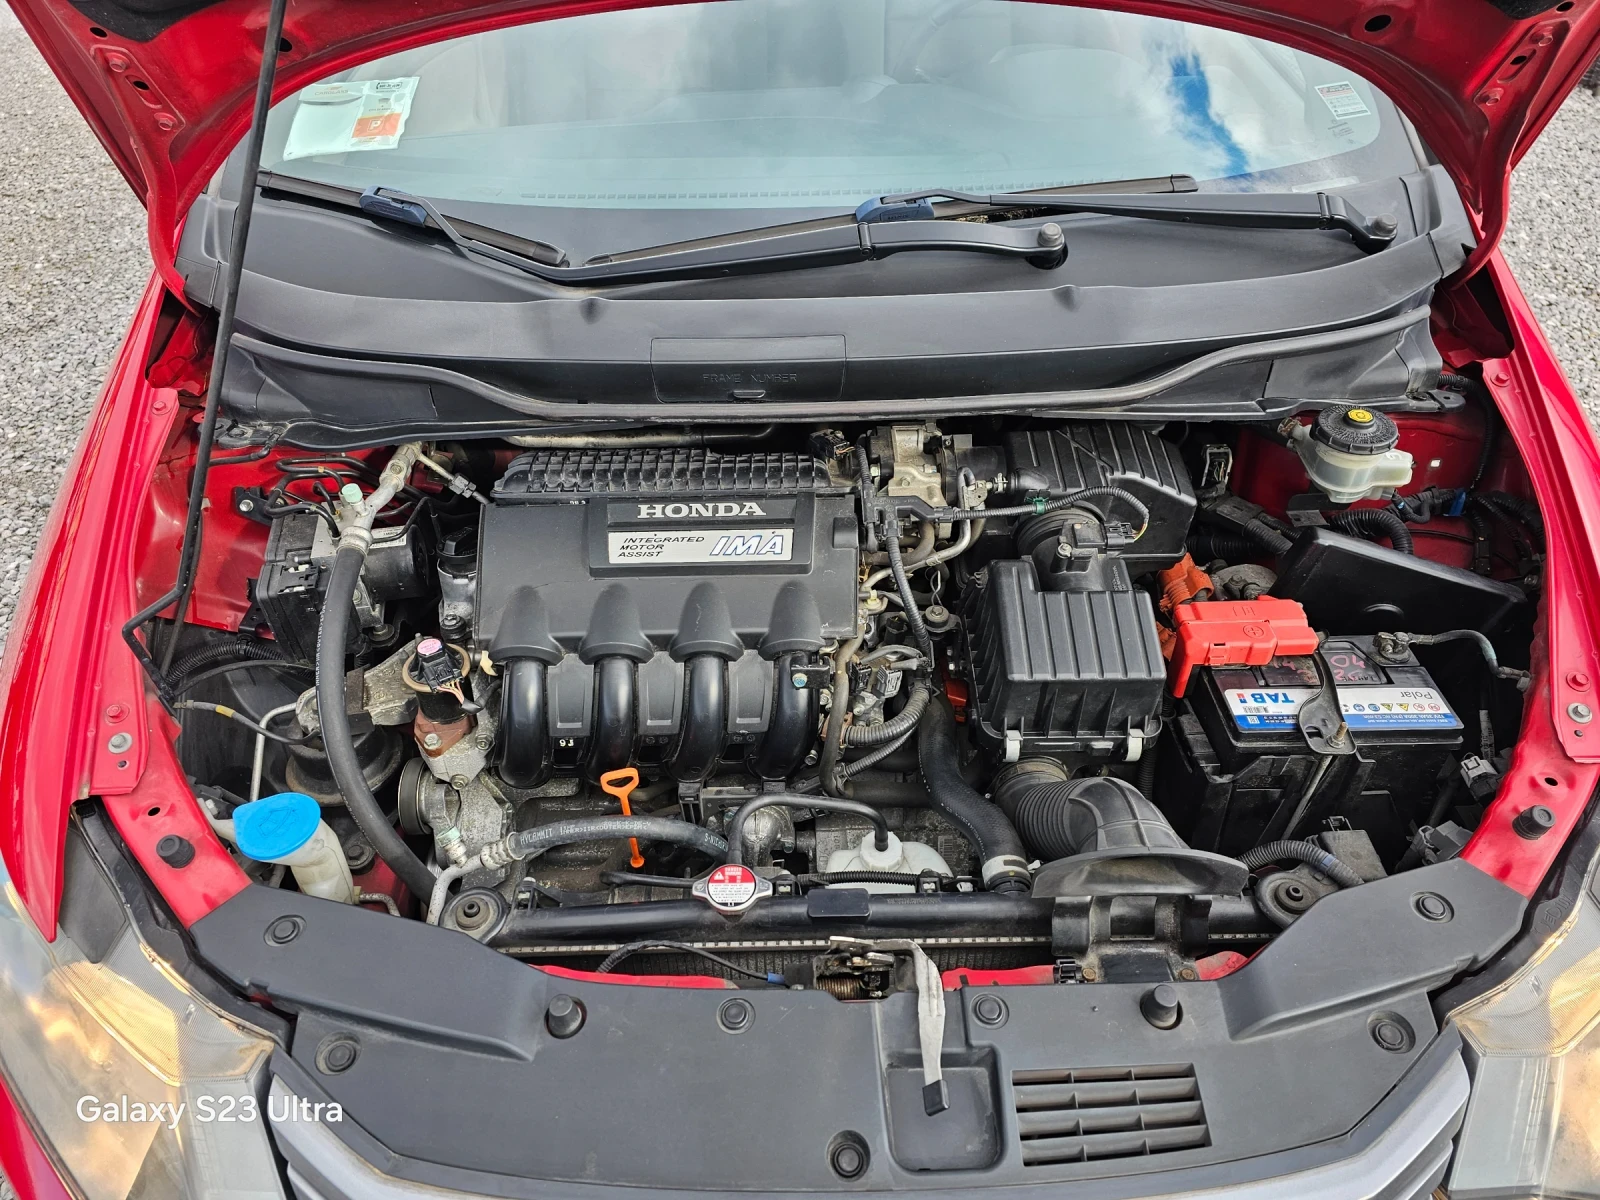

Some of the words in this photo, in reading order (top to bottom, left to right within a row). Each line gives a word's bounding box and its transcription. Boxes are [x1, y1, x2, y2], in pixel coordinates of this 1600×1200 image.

[702, 373, 741, 383] FRAME
[750, 373, 797, 382] NUMBER
[637, 502, 766, 519] HONDA
[623, 536, 705, 544] INTEGRATED
[709, 534, 784, 556] IMA
[619, 543, 664, 551] MOTOR
[617, 550, 662, 558] ASSIST
[1250, 692, 1295, 704] TAB
[1400, 690, 1433, 700] Polar
